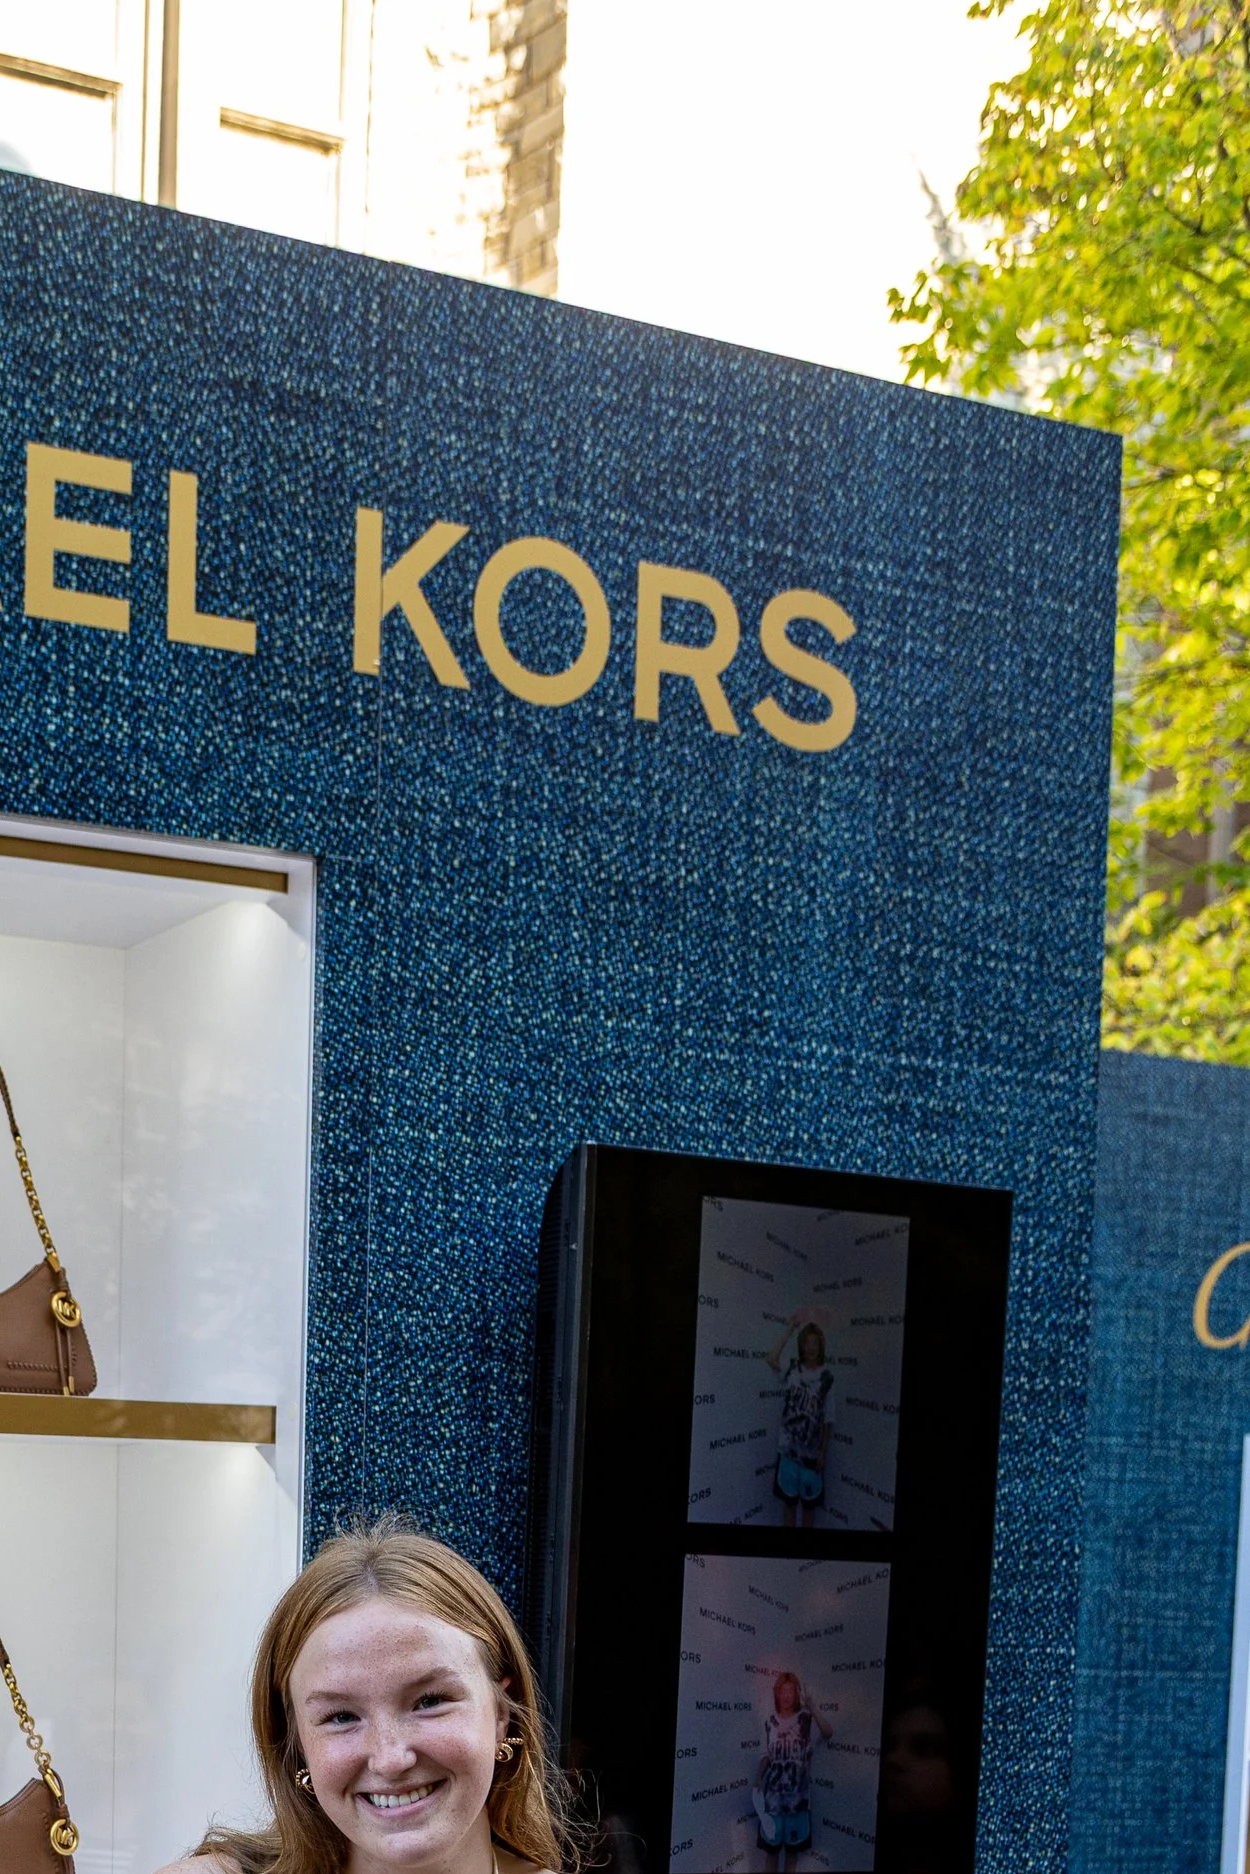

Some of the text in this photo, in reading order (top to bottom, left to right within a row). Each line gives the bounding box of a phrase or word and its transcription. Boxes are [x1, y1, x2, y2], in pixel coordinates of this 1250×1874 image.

[353, 507, 857, 753] KORS
[713, 1347, 749, 1359] MICHAEL
[845, 1397, 880, 1412] MICHAEL
[709, 1433, 746, 1450] MICHAEL
[841, 1474, 875, 1497] MICHAEL
[688, 1487, 712, 1505] ORS
[836, 1578, 871, 1595] MICHAEL
[699, 1607, 755, 1636] MICHAEL KORS
[794, 1630, 822, 1642] MICHAEL
[831, 1659, 866, 1673] MICHAEL
[695, 1701, 752, 1711] MICHAEL KORS
[826, 1741, 860, 1755] MICHAEL
[691, 1778, 748, 1802] MICHAEL KORS
[822, 1818, 856, 1838] MICHAEL
